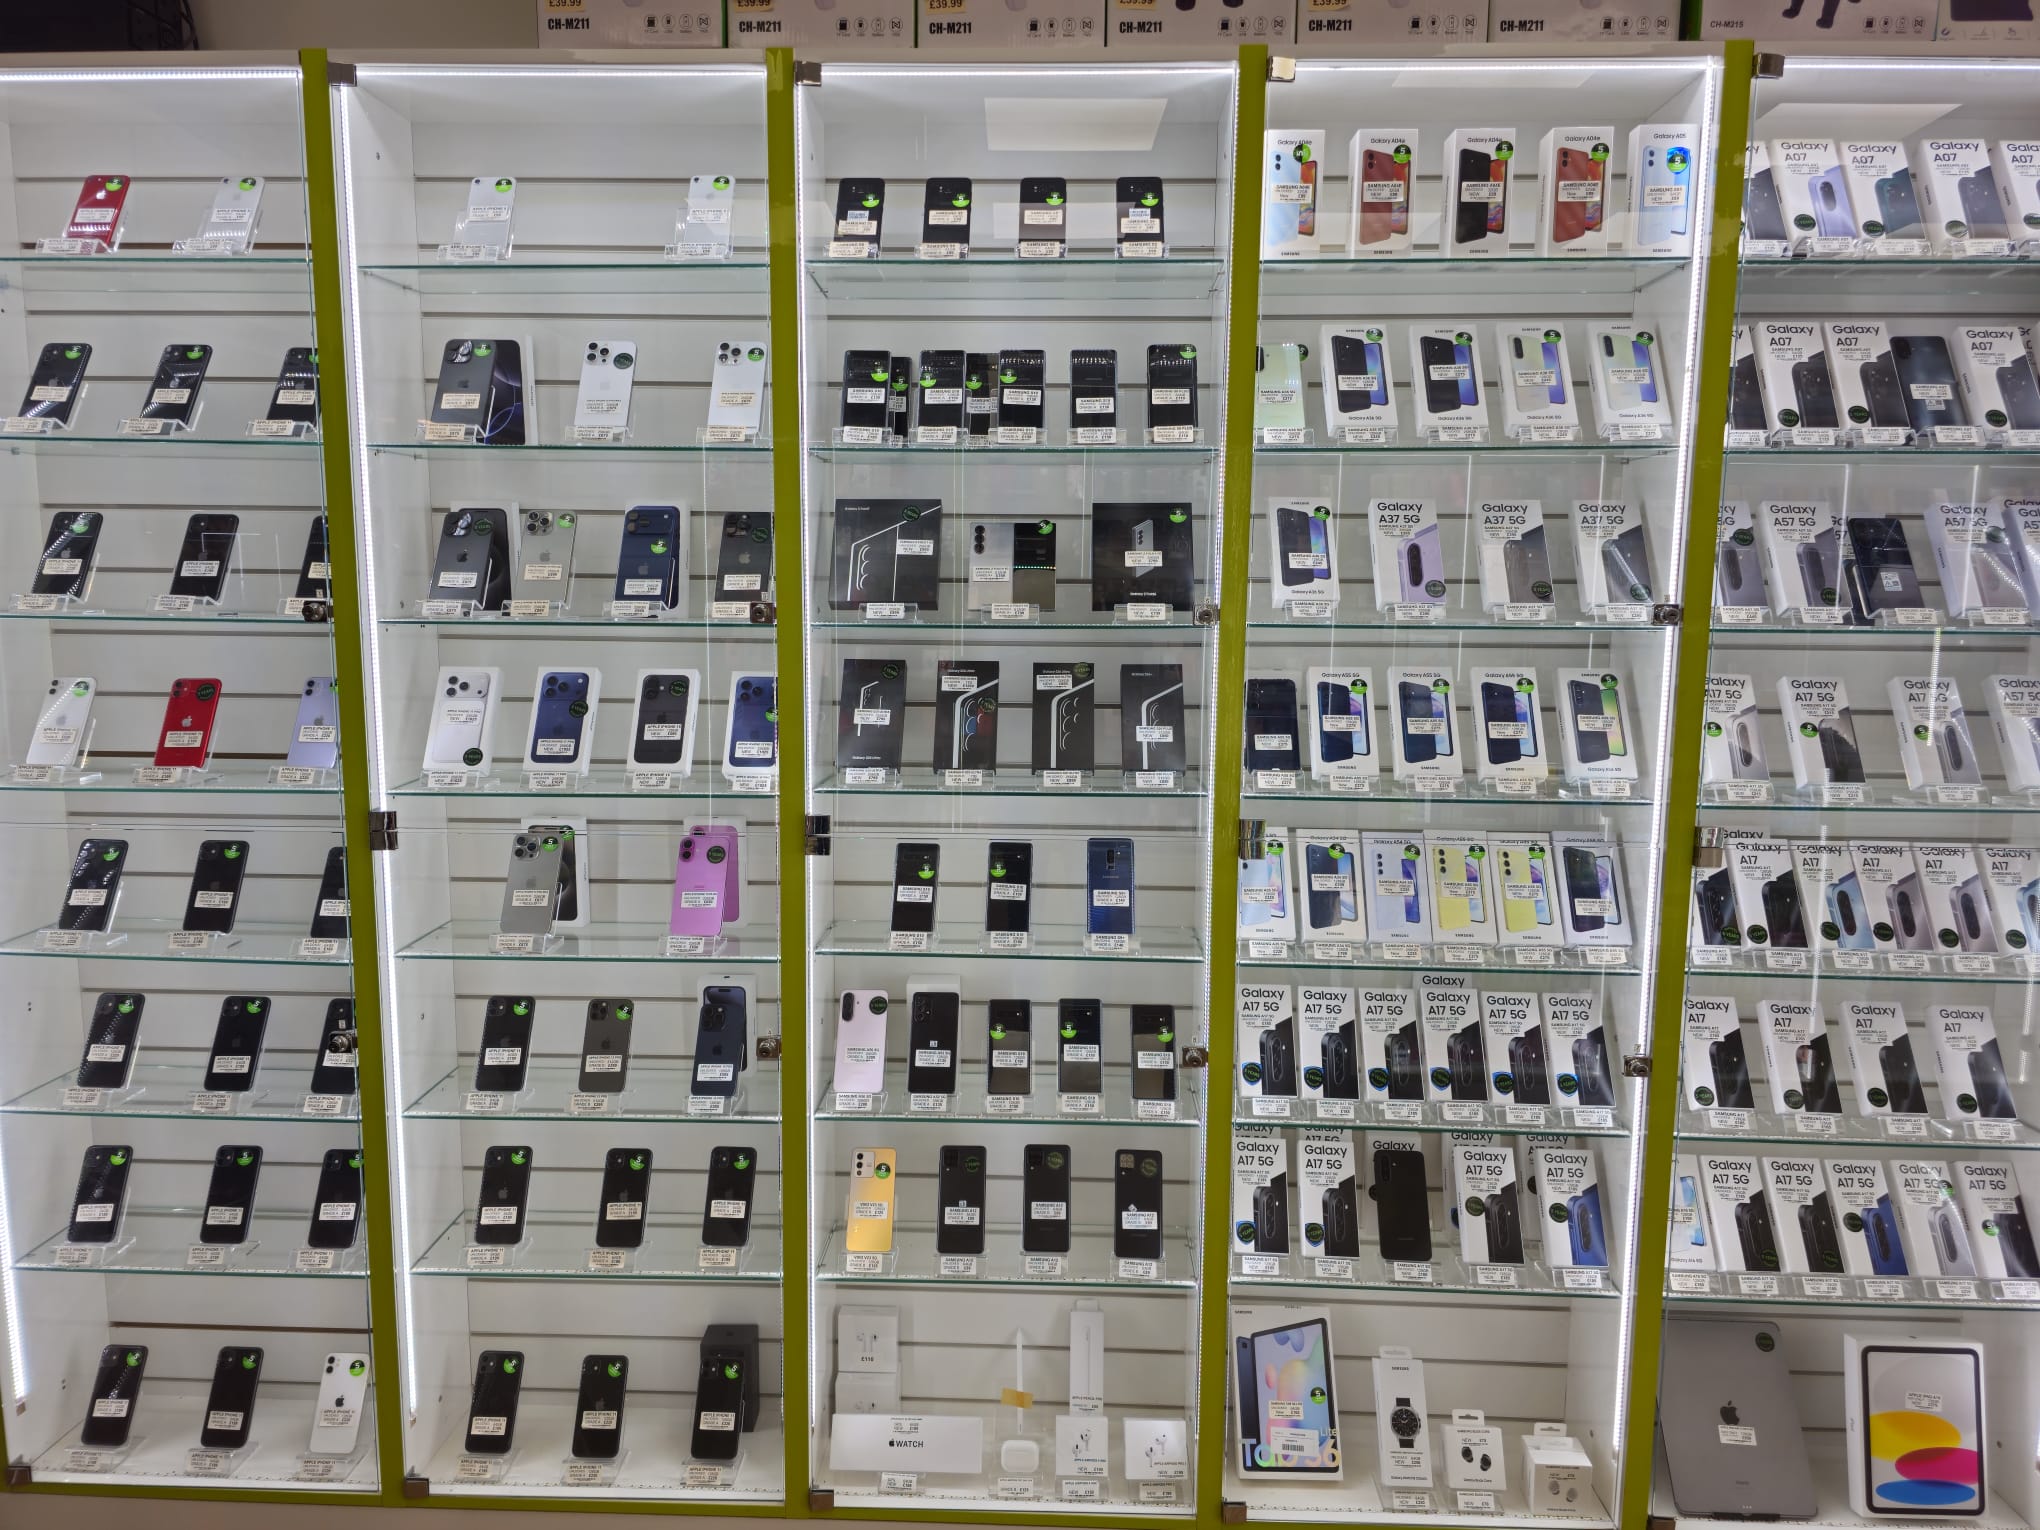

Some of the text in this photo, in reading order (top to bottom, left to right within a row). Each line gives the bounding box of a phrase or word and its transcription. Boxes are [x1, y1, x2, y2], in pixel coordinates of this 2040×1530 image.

[548, 18, 590, 30] CH-M211
[738, 21, 782, 33] CH-M211
[929, 22, 972, 34] CH-M211
[1119, 21, 1162, 33] CH-M211
[1308, 20, 1352, 32] CH-M211
[1500, 20, 1544, 32] CH-M211
[1781, 142, 1828, 152] Galaxy
[1848, 144, 1896, 154] Galaxy
[1930, 142, 1979, 151] Galaxy
[1785, 153, 1806, 161] A07
[1852, 156, 1874, 164] A07
[1934, 153, 1956, 162] A07
[2011, 155, 2033, 163] A07
[1766, 325, 1813, 336] Galaxy
[1832, 325, 1879, 336] Galaxy
[1966, 330, 2013, 340] Galaxy
[1770, 337, 1792, 346] A07
[1836, 338, 1858, 346] A07
[1971, 342, 1993, 350] A07
[1377, 502, 1423, 513] Galaxy
[1482, 504, 1528, 515] Galaxy
[1579, 503, 1626, 514] Galaxy
[1770, 505, 1816, 515] Galaxy
[1940, 505, 1987, 516] Galaxy
[1379, 514, 1420, 524] A37 5G
[1484, 515, 1526, 525] A37 5G
[1581, 515, 1624, 525] A37 5G
[1774, 517, 1816, 526] A57 5G
[1945, 518, 1966, 526] A57
[1792, 680, 1837, 692] Galaxy
[1726, 690, 1742, 699] 5G
[1795, 692, 1834, 702] A17 5G
[1908, 693, 1926, 702] A17
[1736, 842, 1781, 853] Galaxy
[1740, 856, 1757, 865] A17
[1802, 858, 1819, 866] A17
[1863, 858, 1880, 867] A17
[1925, 860, 1942, 869] A17
[1992, 862, 2008, 871] A17
[1422, 976, 1465, 987] Galaxy
[1242, 988, 1285, 1000] Galaxy
[1304, 990, 1347, 1002] Galaxy
[1364, 992, 1408, 1004] Galaxy
[1427, 992, 1470, 1004] Galaxy
[1243, 1002, 1280, 1011] A17 5G
[1487, 996, 1531, 1008] Galaxy
[1548, 997, 1593, 1009] Galaxy
[1686, 1000, 1729, 1012] Galaxy
[1305, 1004, 1342, 1014] A17 5G
[1366, 1006, 1403, 1015] A17 5G
[1428, 1006, 1466, 1016] A17 5G
[1851, 1006, 1896, 1018] Galaxy
[1489, 1010, 1527, 1019] A17 5G
[1551, 1011, 1589, 1020] A17 5G
[1688, 1014, 1705, 1023] A17
[1940, 1009, 1984, 1022] Galaxy
[1774, 1018, 1791, 1027] A17
[1856, 1018, 1873, 1028] A17
[1944, 1023, 1961, 1032] A17
[1237, 1142, 1279, 1155] Galaxy
[1373, 1140, 1415, 1151] Galaxy
[1305, 1145, 1347, 1158] Galaxy
[1237, 1156, 1274, 1166] A17 5G
[1464, 1151, 1507, 1164] Galaxy
[1544, 1154, 1588, 1166] Galaxy
[1306, 1159, 1342, 1169] A17 5G
[1709, 1160, 1751, 1172] Galaxy
[1771, 1161, 1814, 1174] Galaxy
[1466, 1166, 1503, 1175] A17 5G
[1547, 1168, 1584, 1178] A17 5G
[1832, 1165, 1876, 1178] Galaxy
[1899, 1164, 1942, 1177] Galaxy
[1964, 1166, 2007, 1178] Galaxy
[1712, 1175, 1749, 1184] A17 5G
[1775, 1176, 1812, 1185] A17 5G
[1837, 1178, 1874, 1188] A17 5G
[1904, 1179, 1920, 1188] A17
[1969, 1180, 2006, 1190] A17 5G
